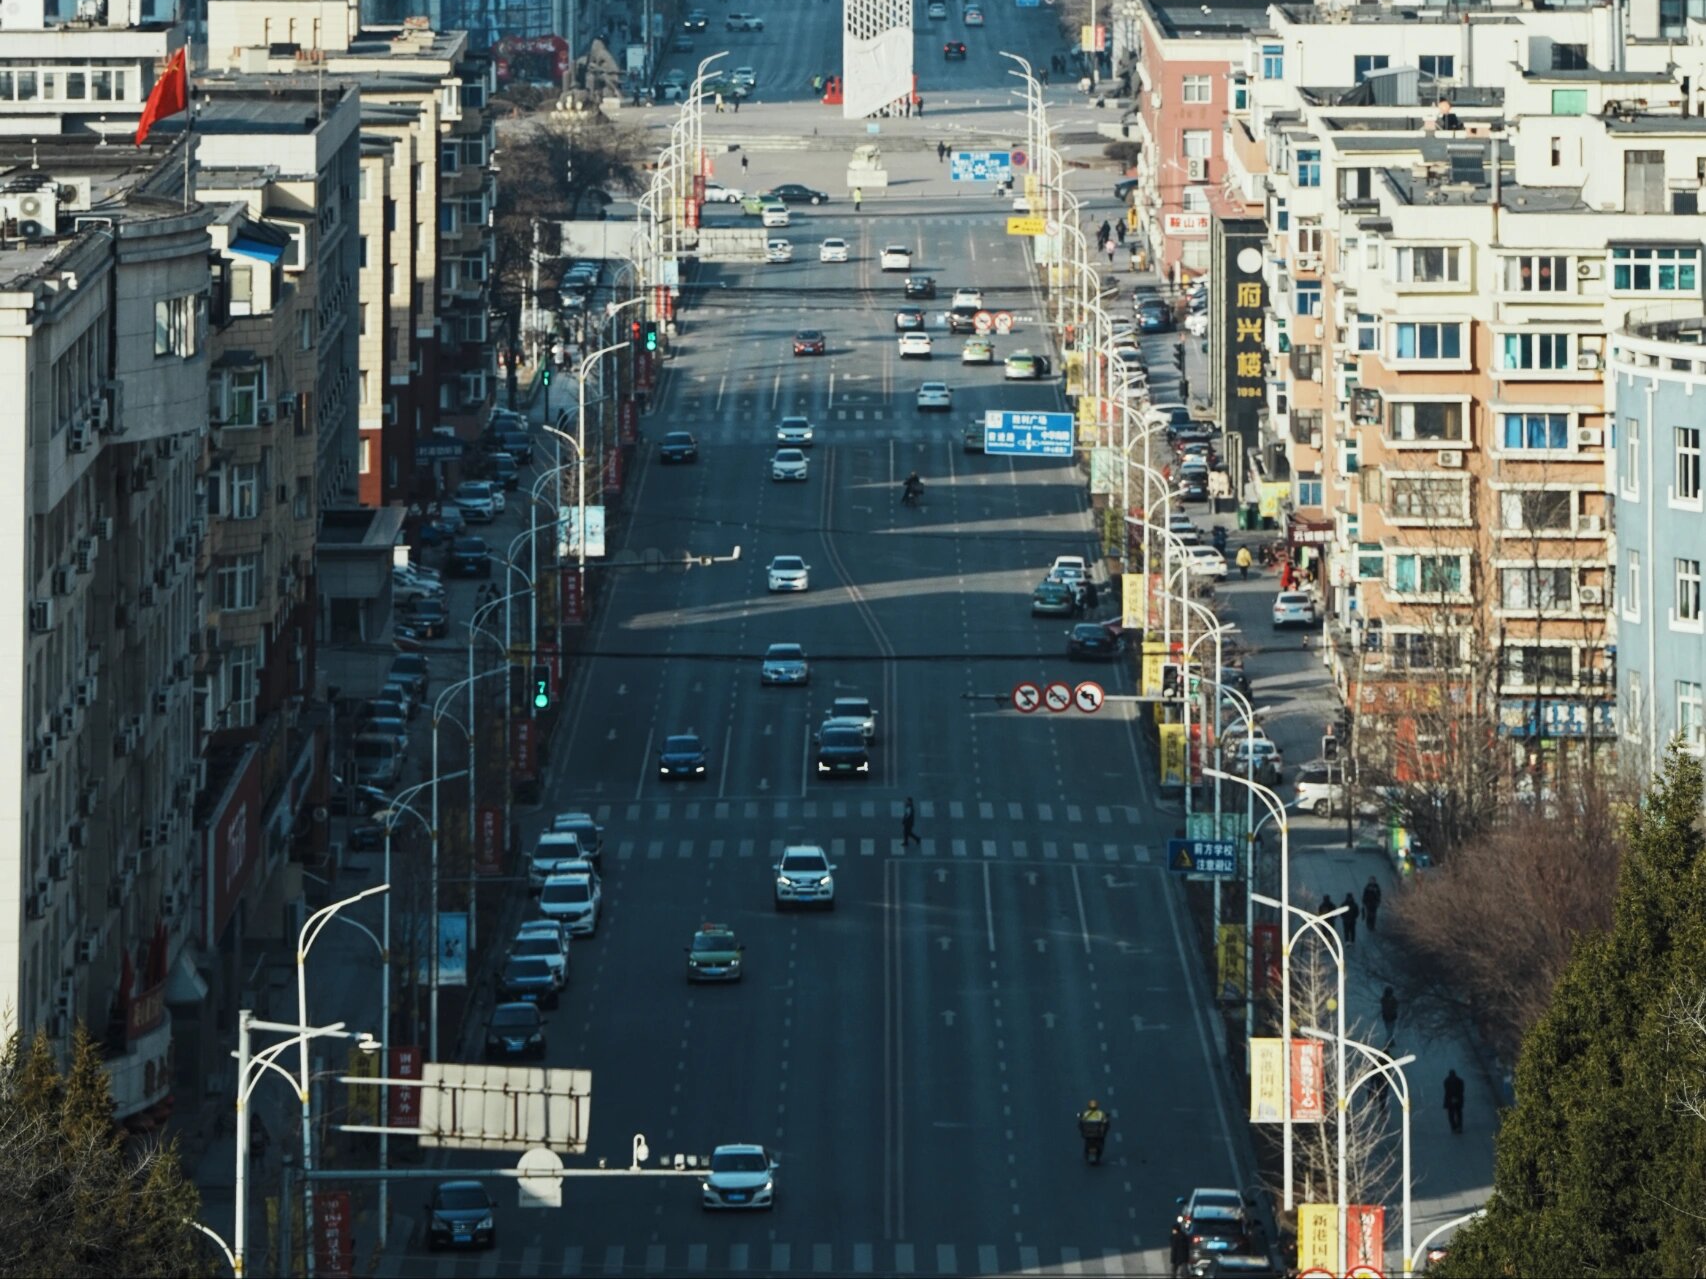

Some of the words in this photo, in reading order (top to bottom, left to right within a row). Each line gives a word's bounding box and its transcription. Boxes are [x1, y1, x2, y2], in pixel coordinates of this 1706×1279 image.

[1237, 282, 1262, 377] 府兴楼
[537, 681, 546, 694] 7
[1194, 843, 1233, 856] 前方学校
[1197, 859, 1233, 872] 注意避让
